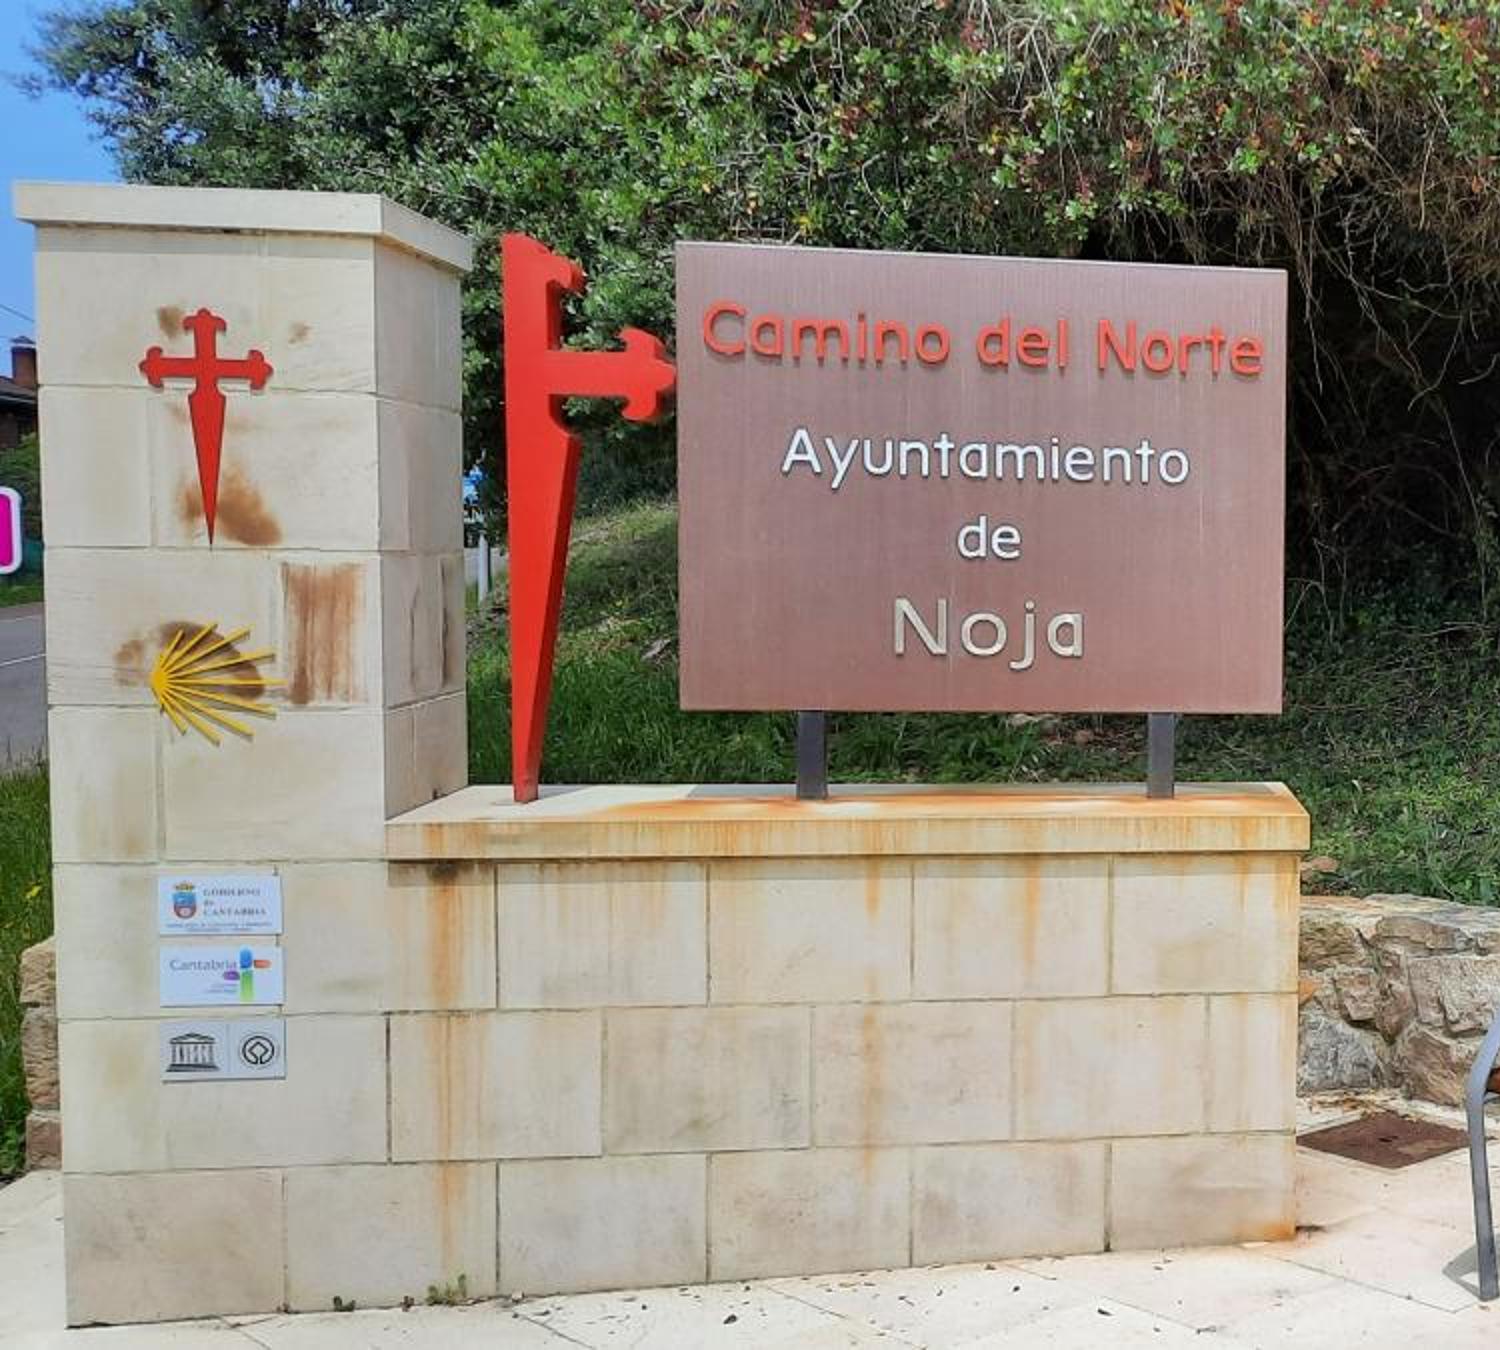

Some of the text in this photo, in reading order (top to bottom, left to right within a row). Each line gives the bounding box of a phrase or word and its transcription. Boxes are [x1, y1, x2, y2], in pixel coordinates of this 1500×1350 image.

[702, 303, 1265, 376] Camino del Norte
[782, 428, 1190, 489] Ayuntamiento
[957, 515, 1022, 560] de
[894, 597, 1086, 671] Noja
[169, 958, 238, 971] Cantabria
